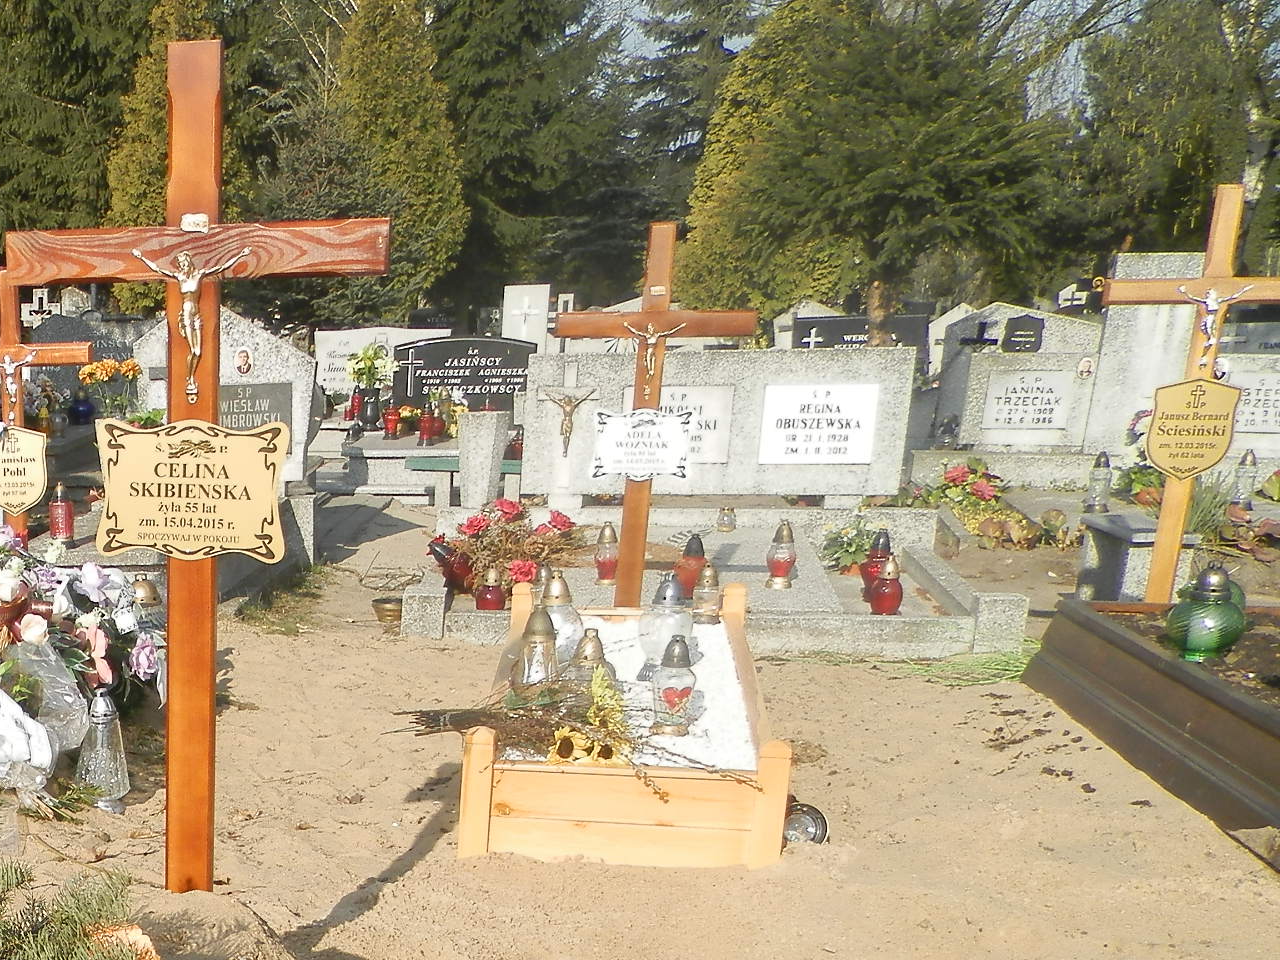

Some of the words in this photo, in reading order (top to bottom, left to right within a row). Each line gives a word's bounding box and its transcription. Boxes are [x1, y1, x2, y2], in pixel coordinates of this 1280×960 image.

[444, 356, 502, 367] JASIŃSCY
[415, 369, 471, 377] FRANCISZEK
[1004, 386, 1055, 396] JANINA
[220, 399, 270, 413] WIESŁAW
[993, 395, 1062, 406] TRZECIAK
[799, 403, 842, 414] REGINA
[1158, 411, 1190, 421] Janusz
[1192, 411, 1230, 421] Bernard
[775, 417, 862, 430] OBUSZEWSKA
[1157, 421, 1226, 437] Ściesiński
[3, 467, 26, 477] Pohl
[154, 462, 230, 480] CELINA
[158, 501, 181, 515] żyła
[184, 502, 199, 513] 55
[202, 502, 217, 514] lat
[138, 518, 159, 527] zm.
[164, 516, 224, 530] 15.04.2015
[227, 521, 236, 531] r.
